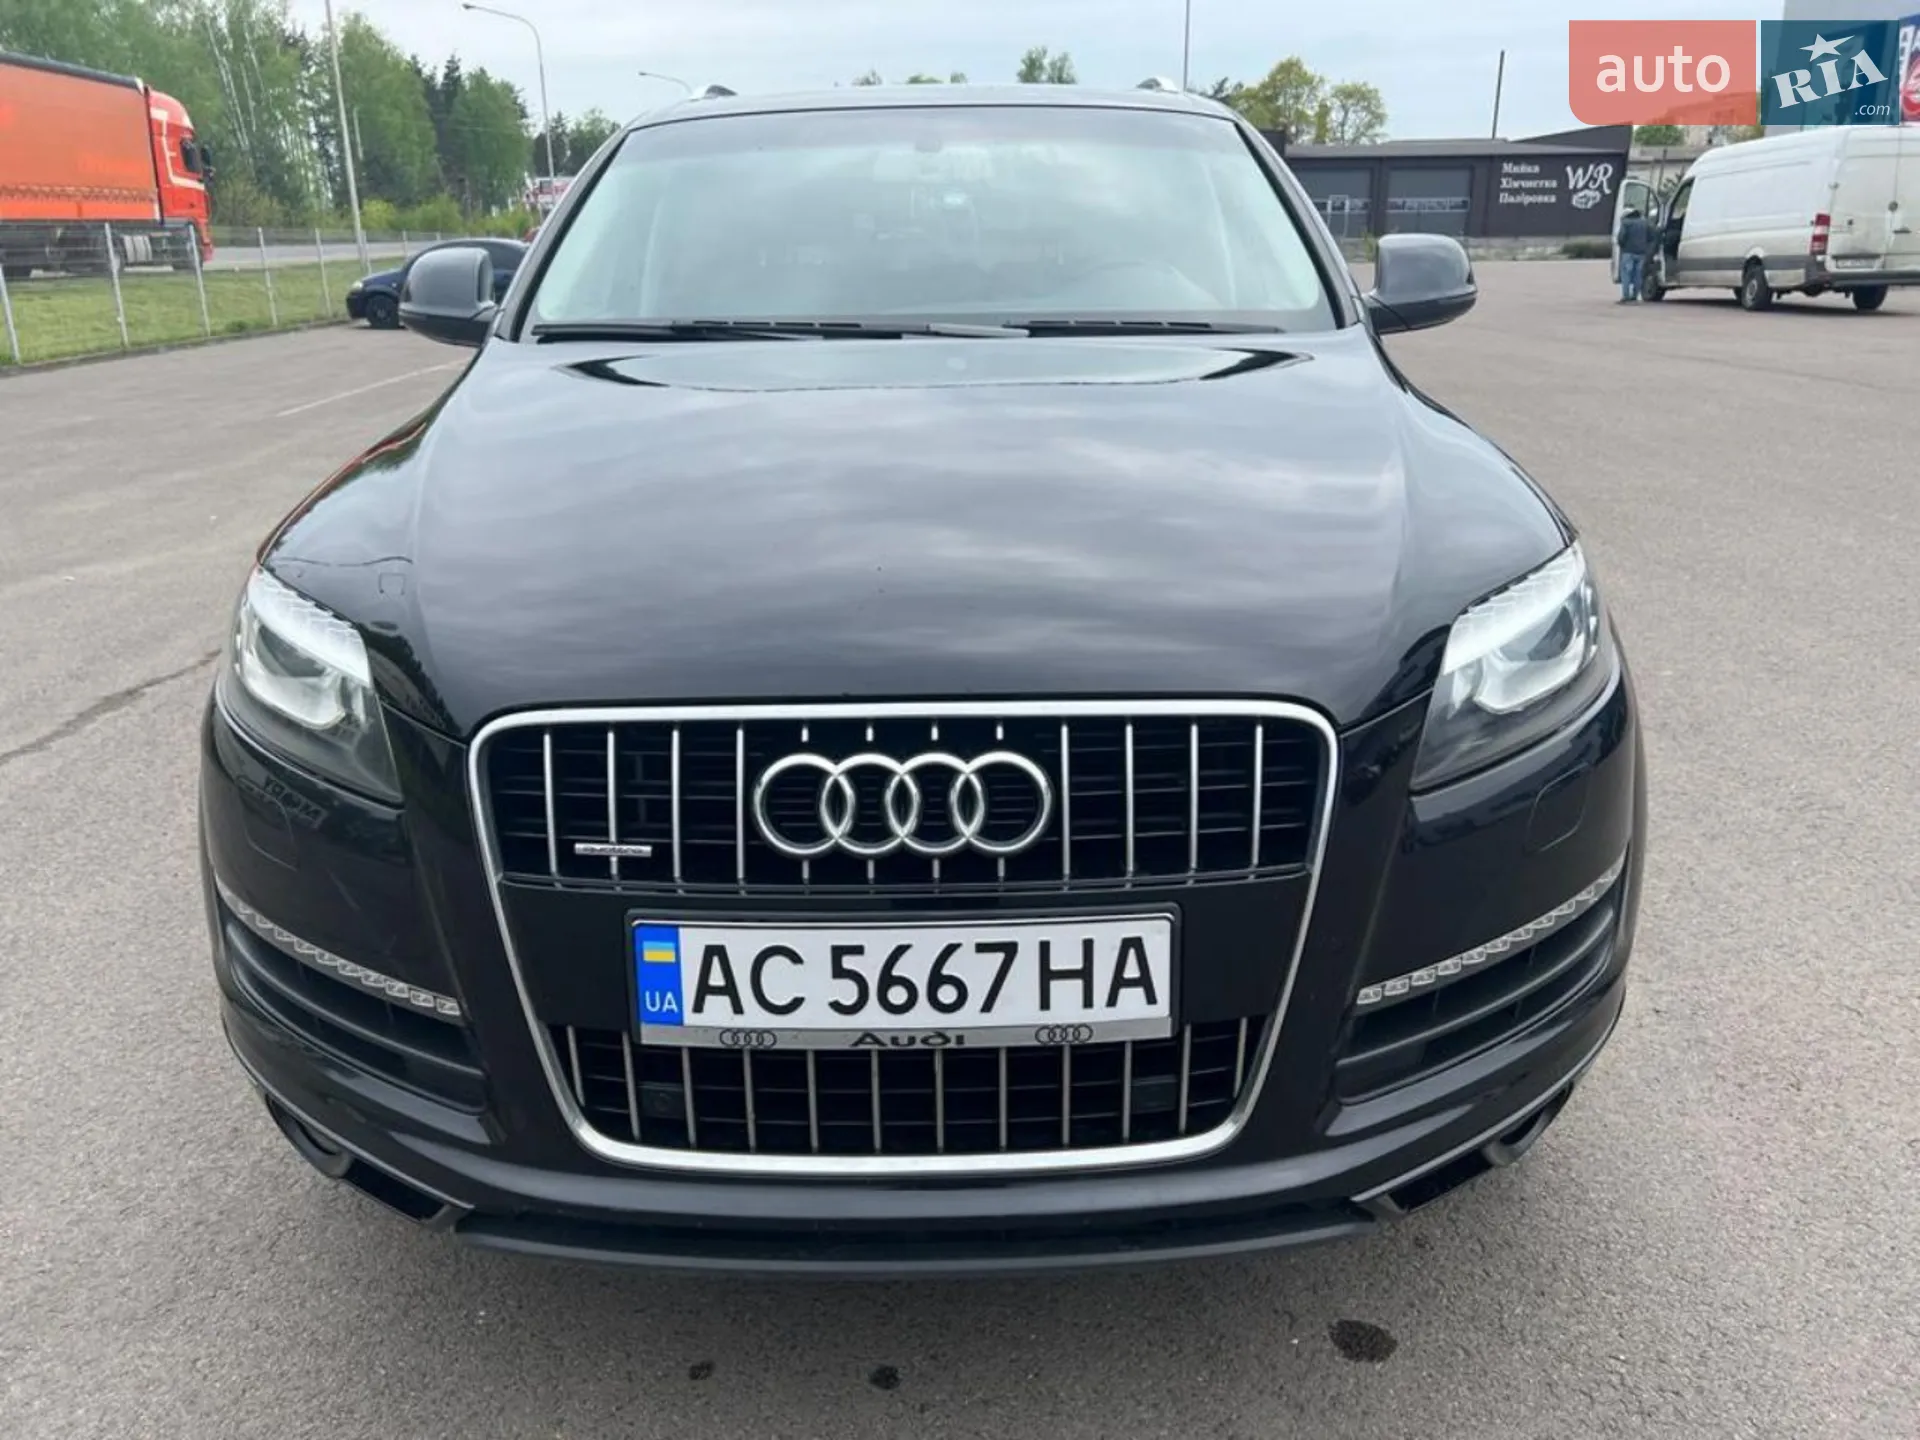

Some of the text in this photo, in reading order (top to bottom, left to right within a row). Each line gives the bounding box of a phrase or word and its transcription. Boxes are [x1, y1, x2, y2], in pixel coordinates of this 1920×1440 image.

[692, 936, 1158, 1015] AC 5667 HA
[645, 991, 678, 1013] UA
[851, 1031, 965, 1047] Audi
